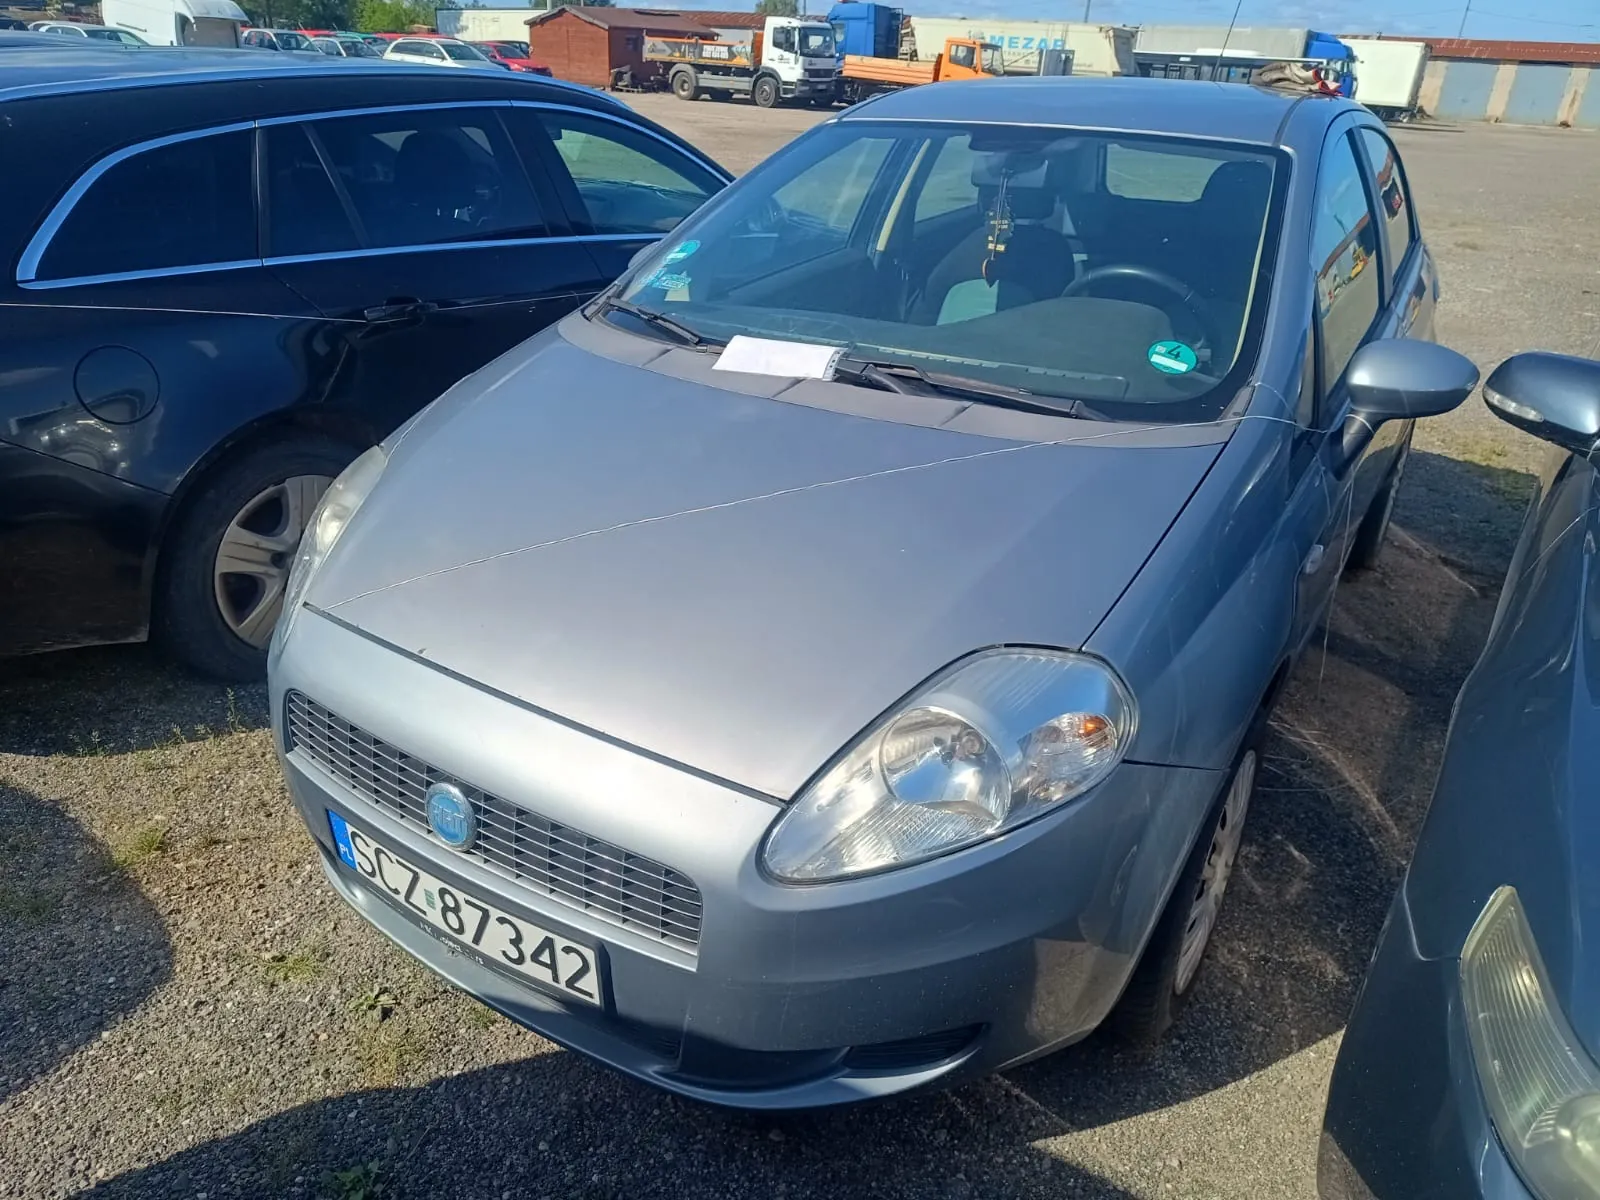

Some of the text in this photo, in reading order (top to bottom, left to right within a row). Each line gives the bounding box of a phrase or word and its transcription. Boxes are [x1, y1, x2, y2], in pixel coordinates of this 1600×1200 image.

[1167, 344, 1182, 360] 4
[338, 842, 354, 861] PL
[350, 830, 427, 917] SCZ
[437, 886, 594, 999] 87342
